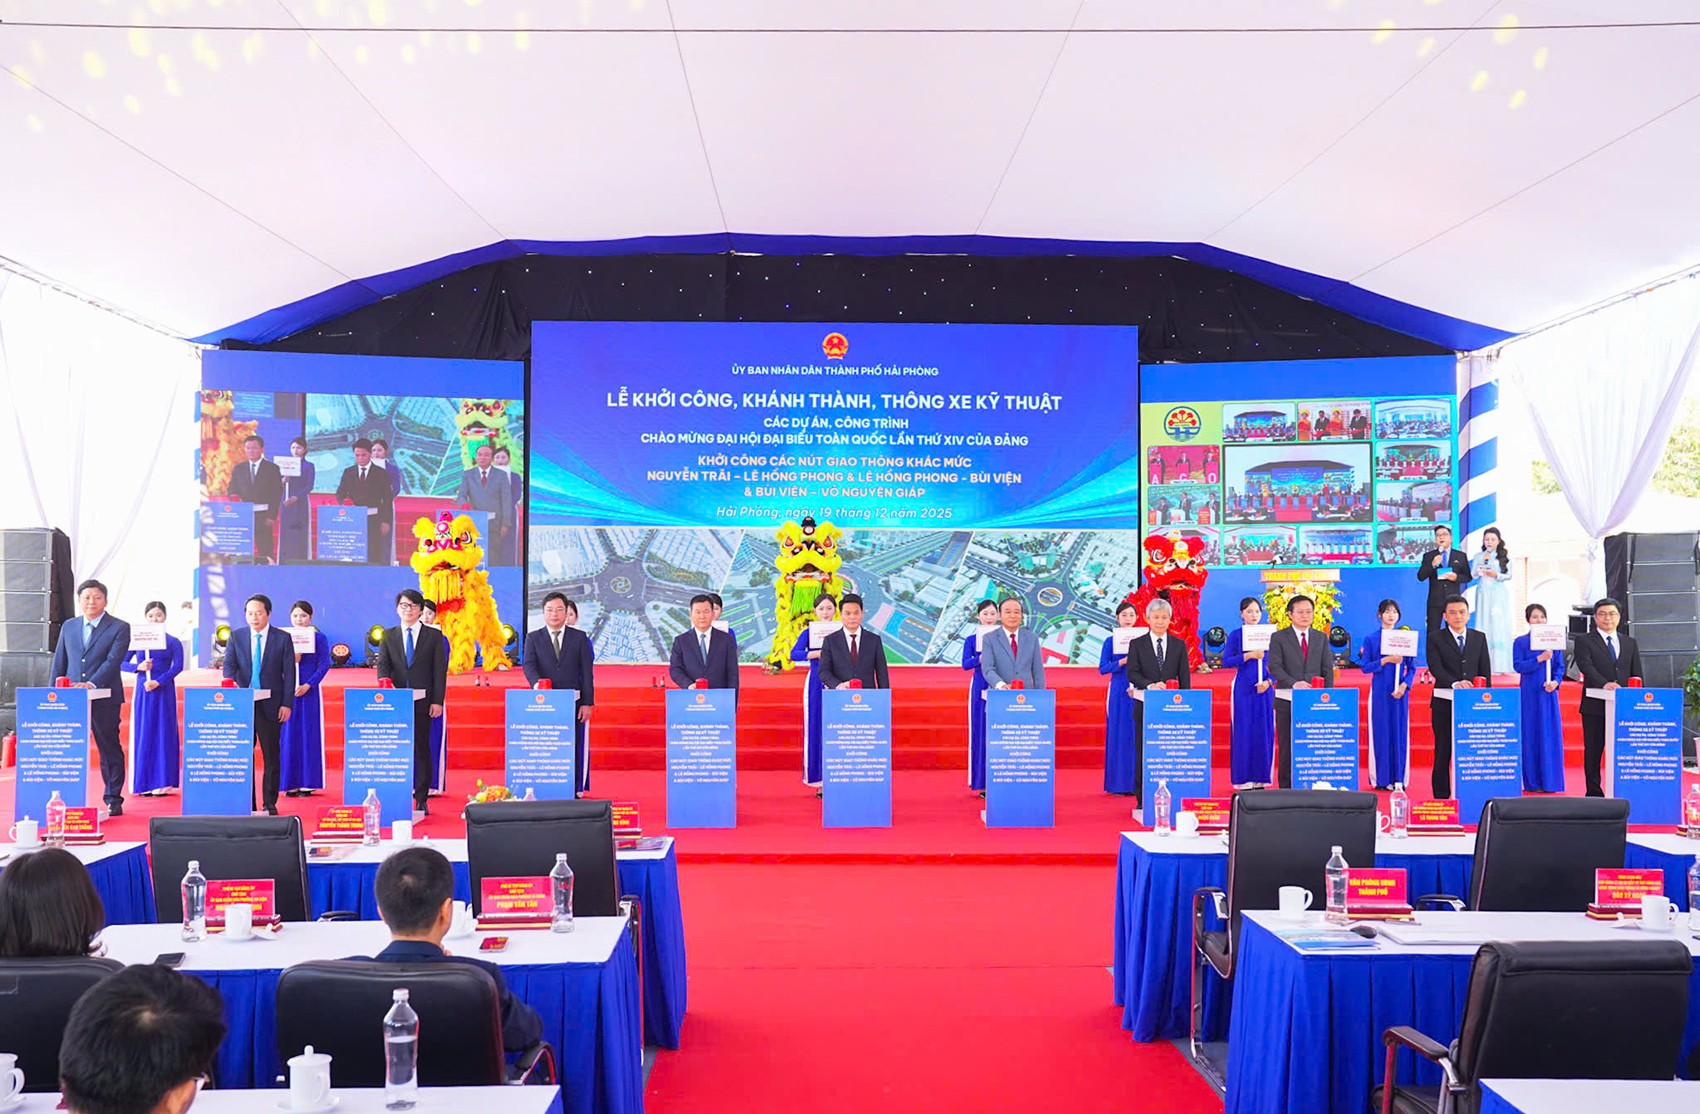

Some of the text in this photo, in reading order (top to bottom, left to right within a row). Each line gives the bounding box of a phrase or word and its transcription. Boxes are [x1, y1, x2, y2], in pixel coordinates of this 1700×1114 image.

[732, 364, 938, 376] ỦY BAN NHÂN DÂN THÀNH PHỐ HẢI PHÒNG
[607, 386, 1062, 414] LỄ KHỞI CÔNG, KHÁNH THÀNH, THÔNG XE KỸ THUẬT
[764, 415, 908, 432] CÁC DỰ ÁN, CÔNG TRÌNH
[641, 431, 1028, 446] CHÀO MỪNG ĐẠI HỘI ĐẠI BIỂU TOÀN QUỐC LẦN THỨ XIV CỦA ĐẢNG
[698, 453, 971, 468] KHỞI CÔNG CÁC NÚT GIAO THÔNG KHÁC MỨC
[744, 487, 752, 496] &
[756, 484, 776, 497] BÙI
[779, 485, 807, 499] VIỆN
[821, 485, 839, 497] VÕ
[842, 486, 892, 498] NGUYÊN
[895, 486, 926, 498] GIÁP
